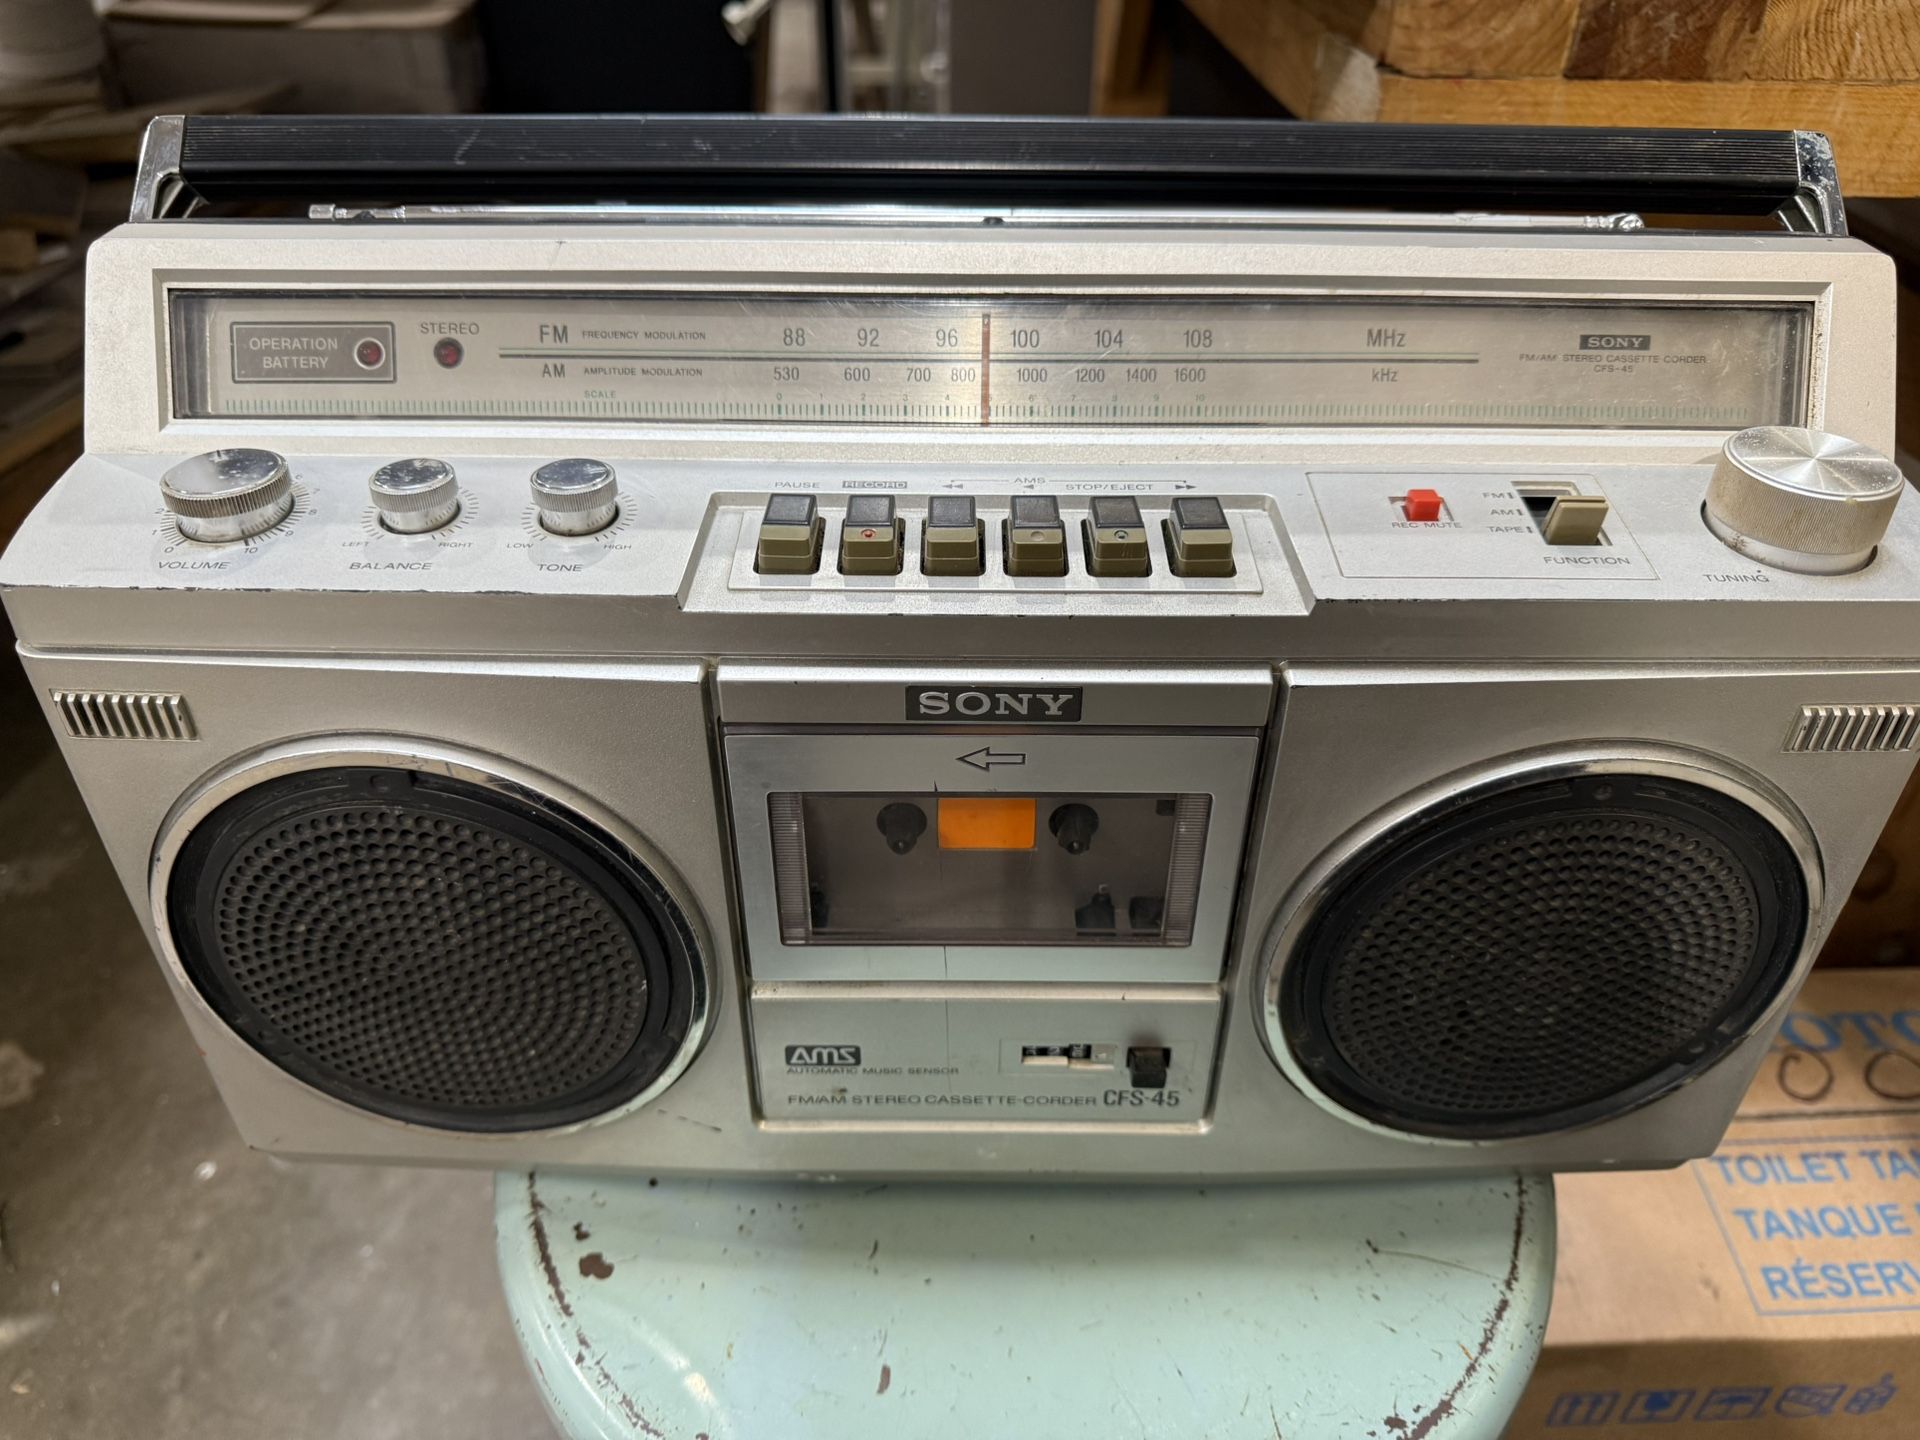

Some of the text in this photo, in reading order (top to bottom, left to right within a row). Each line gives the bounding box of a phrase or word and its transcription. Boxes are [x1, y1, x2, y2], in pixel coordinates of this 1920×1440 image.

[420, 322, 480, 335] STEREO
[539, 325, 569, 344] FM
[582, 330, 706, 340] FREQUENCY MODULATION
[783, 328, 1406, 348] 88 92 96 100 104 108 MHz
[249, 337, 338, 350] OPERATION
[1587, 337, 1644, 349] SONY
[263, 356, 329, 369] BATTERY
[1519, 353, 1707, 364] FM/AM STEREO CASSETTE CORDER
[542, 363, 566, 378] AM
[584, 367, 702, 376] AMPLITUDE MODULATION
[1593, 364, 1634, 373] CFS-45
[773, 366, 1399, 383] 530 600 700 800 1000 1200 1400 1600 kHz
[584, 390, 616, 399] SCALE
[842, 481, 908, 489] RECORD
[1065, 483, 1153, 491] STOP/EJECT
[1487, 526, 1524, 534] TAPE
[438, 541, 474, 549] RIGHT
[158, 561, 231, 570] VOLUME
[1543, 556, 1631, 566] FUNCTION
[349, 562, 433, 571] BALANCE
[537, 563, 584, 573] TONE
[1702, 574, 1770, 583] TUNING
[918, 691, 1074, 716] SONY
[786, 1067, 960, 1075] AUTOMATIC MUSIC SENSOR
[788, 1095, 847, 1105] FM/AM
[851, 1094, 921, 1105] STEREO
[1103, 1090, 1181, 1107] CFS-45
[1708, 1149, 1920, 1186] TOILET TA
[1734, 1202, 1914, 1242] TANQUE
